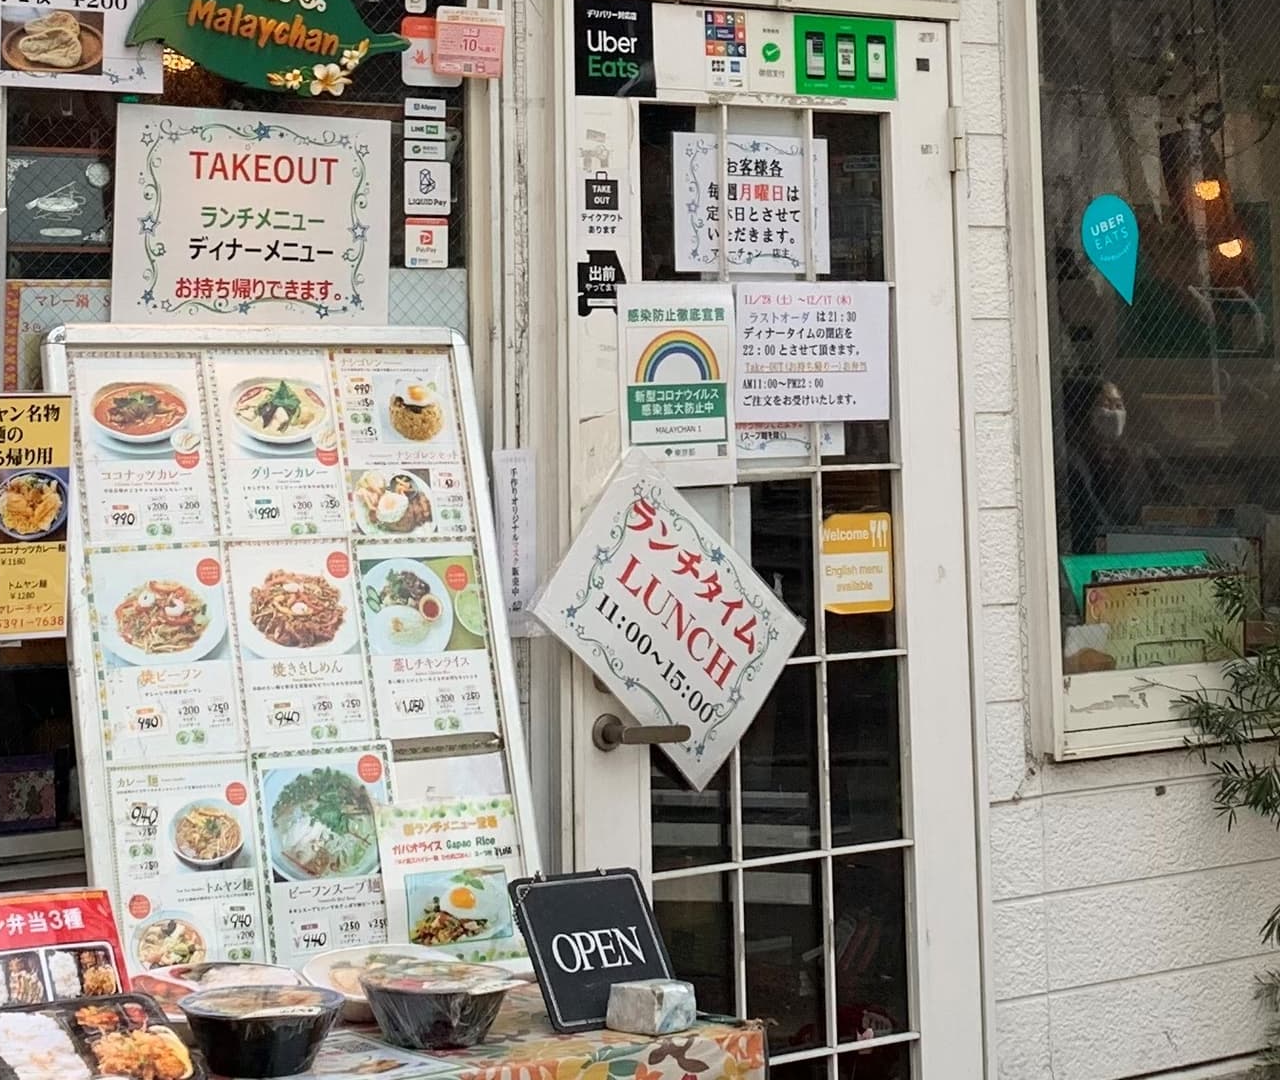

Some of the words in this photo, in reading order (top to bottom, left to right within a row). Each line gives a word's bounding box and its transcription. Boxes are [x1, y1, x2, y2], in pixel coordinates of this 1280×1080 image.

[586, 29, 638, 54] Uber
[588, 55, 640, 79] Eats
[188, 150, 340, 187] TAKEOUT
[592, 185, 611, 194] TAKE
[433, 198, 447, 207] Pay
[594, 196, 611, 205] OUT
[199, 206, 325, 232] ランチメニュー
[581, 213, 623, 223] テイクアウト
[1090, 213, 1125, 237] UBER
[588, 225, 617, 235] あります
[1095, 226, 1129, 250] EATS
[188, 236, 335, 263] ディナーメニュー
[588, 265, 616, 282] 出前
[174, 278, 343, 303] お持ち帰りできます。
[627, 307, 725, 323] 感染防止徹底宣言
[634, 387, 720, 404] 新型コロナウイルス
[641, 402, 715, 417] 感染拡大防止中
[655, 425, 696, 434] MALAYCHAN
[101, 469, 193, 481] ココナッツカレー
[251, 466, 329, 480] グリーンカレー
[822, 526, 870, 542] Welcome
[627, 497, 759, 656] ランチタイム
[825, 563, 858, 578] English
[859, 564, 884, 576] menu
[836, 580, 873, 593] available
[616, 552, 739, 690] LUNCH
[272, 659, 344, 678] 焼ききしめん
[475, 835, 496, 847] Rice
[206, 877, 254, 894] トムヤン麺
[552, 922, 647, 975] OPEN
